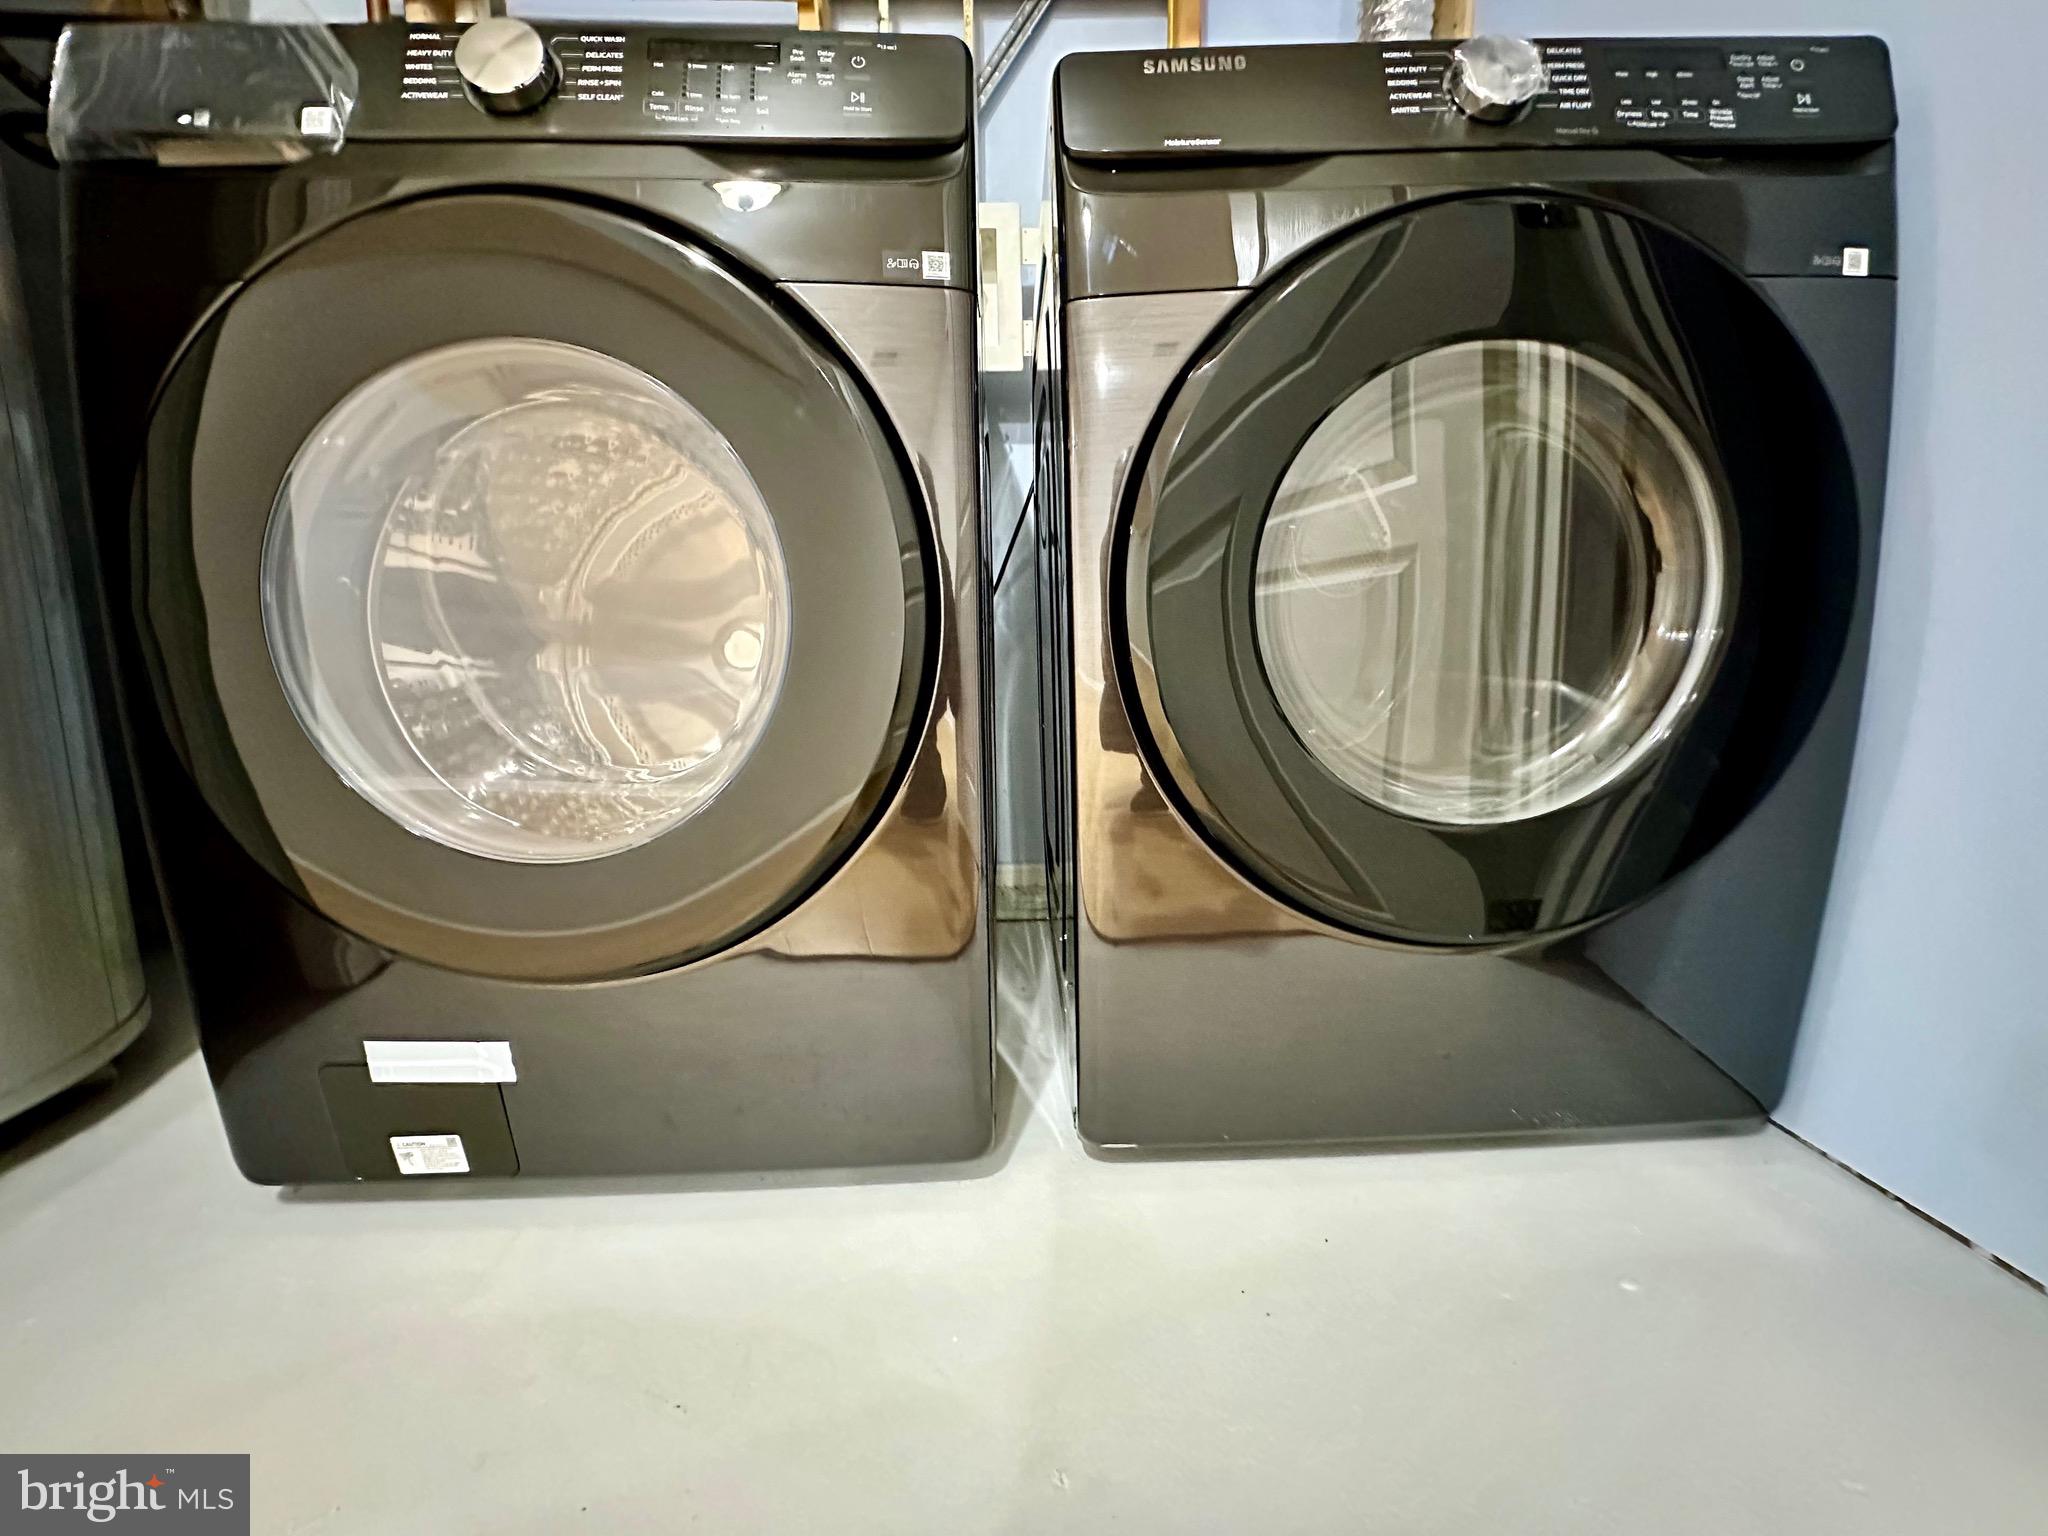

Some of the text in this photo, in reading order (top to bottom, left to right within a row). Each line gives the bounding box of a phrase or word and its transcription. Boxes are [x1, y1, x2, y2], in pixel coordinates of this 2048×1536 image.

[580, 35, 603, 43] QUICK
[585, 51, 624, 59] DELICATES
[816, 49, 836, 58] Delay
[1382, 51, 1413, 59] NORMAL
[1546, 47, 1583, 55] DELICATES
[404, 63, 434, 71] WHITES
[1143, 54, 1247, 74] SAMSUNG
[601, 65, 623, 73] PRESS
[1385, 65, 1428, 74] HEAVY DUTY
[815, 72, 835, 80] Smart
[1551, 74, 1588, 82] QUICK DRY
[402, 77, 437, 85] BEDDING
[1387, 79, 1418, 87] BEDDING
[400, 91, 449, 99] ACTIVEWEAR
[1558, 87, 1590, 95] TIME DRY
[577, 93, 596, 101] SELF
[1389, 91, 1433, 100] ACTIVEWEAR
[649, 103, 671, 111] Temp.
[684, 104, 705, 112] Rinse
[1559, 101, 1571, 109] AIR
[721, 105, 737, 114] Spin
[756, 107, 769, 115] Soil
[1391, 105, 1421, 114] SANITIZE
[1682, 110, 1699, 118] Time
[1163, 137, 1222, 147] MoistureSensor
